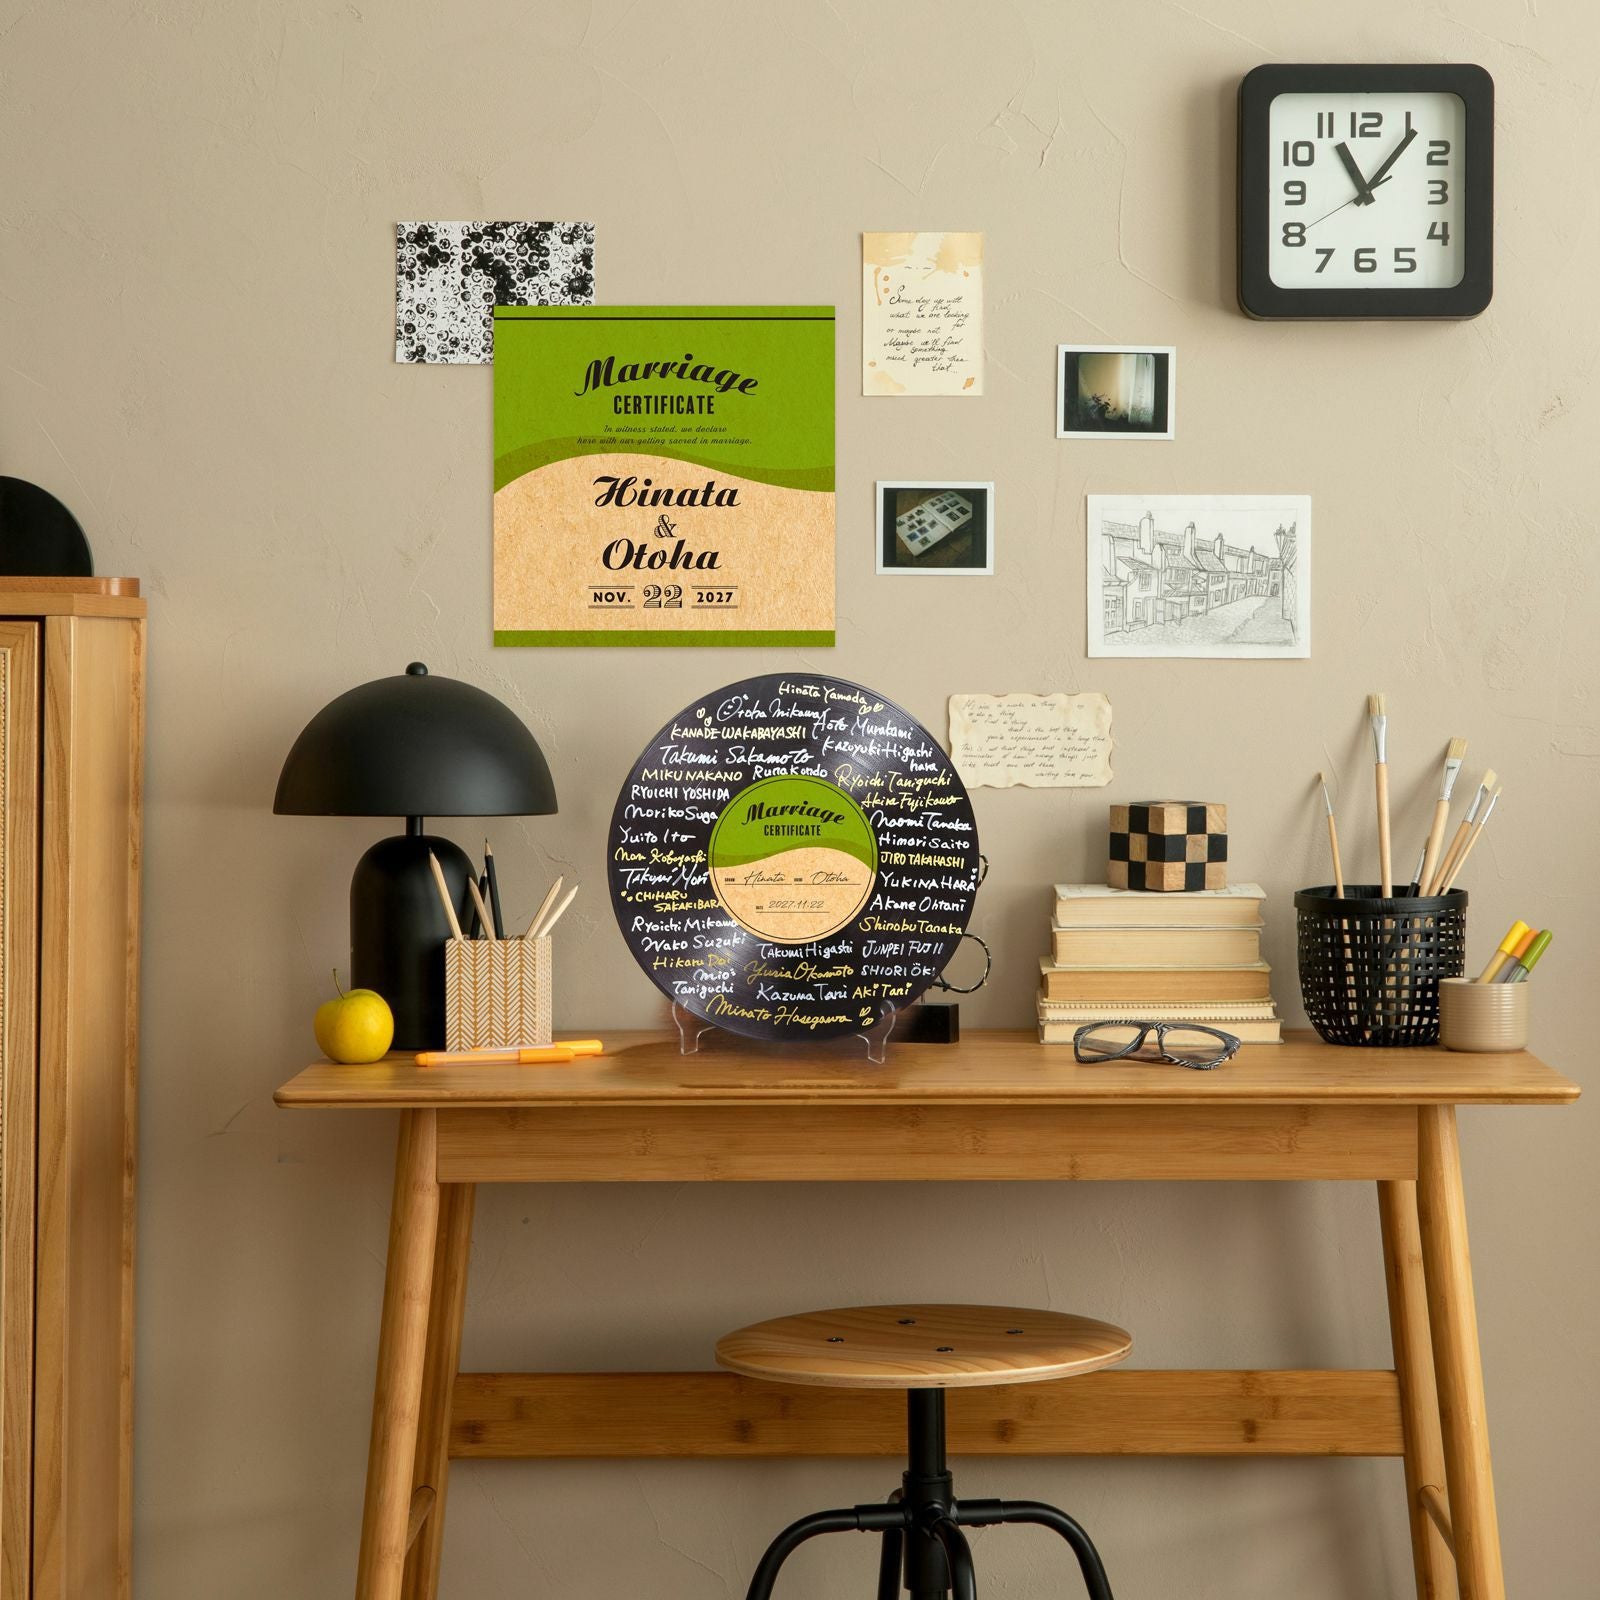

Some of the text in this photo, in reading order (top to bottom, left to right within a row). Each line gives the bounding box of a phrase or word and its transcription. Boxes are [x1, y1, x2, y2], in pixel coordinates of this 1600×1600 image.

[1317, 112, 1334, 138] 11
[1350, 112, 1383, 138] 12
[1405, 111, 1411, 138] 1
[1283, 140, 1315, 167] 10
[1426, 140, 1451, 166] 2
[1283, 180, 1307, 206] 9
[1427, 180, 1449, 205] 3
[1282, 222, 1307, 247] 8
[1426, 221, 1450, 246] 4
[1314, 248, 1336, 273] 7
[1354, 248, 1377, 273] 6
[1394, 247, 1417, 273] 5
[574, 353, 759, 396] Marriage
[613, 395, 715, 415] CERTIFICATE
[604, 425, 613, 433] In
[615, 425, 646, 433] witness
[696, 425, 727, 433] declare
[577, 436, 596, 445] here
[600, 436, 617, 444] with
[637, 437, 665, 445] getting
[669, 437, 697, 445] sacred
[711, 437, 752, 446] marriage.
[593, 475, 741, 507] Hinata
[654, 514, 677, 539] &
[602, 538, 722, 570] Otoha
[593, 584, 733, 609] NOV. 22 2027
[778, 681, 867, 704] Hinata Yamada
[670, 723, 806, 740] KANADE WAKABAYASHI
[659, 745, 815, 766] Takumi Sakamoto
[642, 768, 743, 782] MIKU NAKANO
[887, 768, 953, 793] Taniguchi
[631, 784, 730, 801] RYUICHI YOSHIDA
[684, 805, 719, 824] Suga
[741, 800, 846, 825] Marriage
[921, 811, 973, 831] Tanaka
[619, 824, 658, 843] Yuito
[763, 825, 822, 837] CERTIFICATE
[928, 838, 970, 850] Saito
[880, 851, 965, 870] JIRO TAKAHASHI
[743, 870, 787, 888] Hinata
[809, 870, 850, 885] Otoha
[940, 875, 976, 892] HARA
[635, 890, 688, 902] CHIHARU
[768, 900, 825, 910] 2027.11.22
[869, 893, 917, 911] Akane
[859, 915, 963, 935] Shinobu Tanaka
[692, 932, 747, 949] Suzuki
[862, 940, 905, 958] JUNPEI
[652, 956, 705, 970] Hikaru
[861, 965, 907, 977] SHIORI
[672, 980, 734, 999] Taniguchi
[852, 982, 913, 999] Aki Tani
